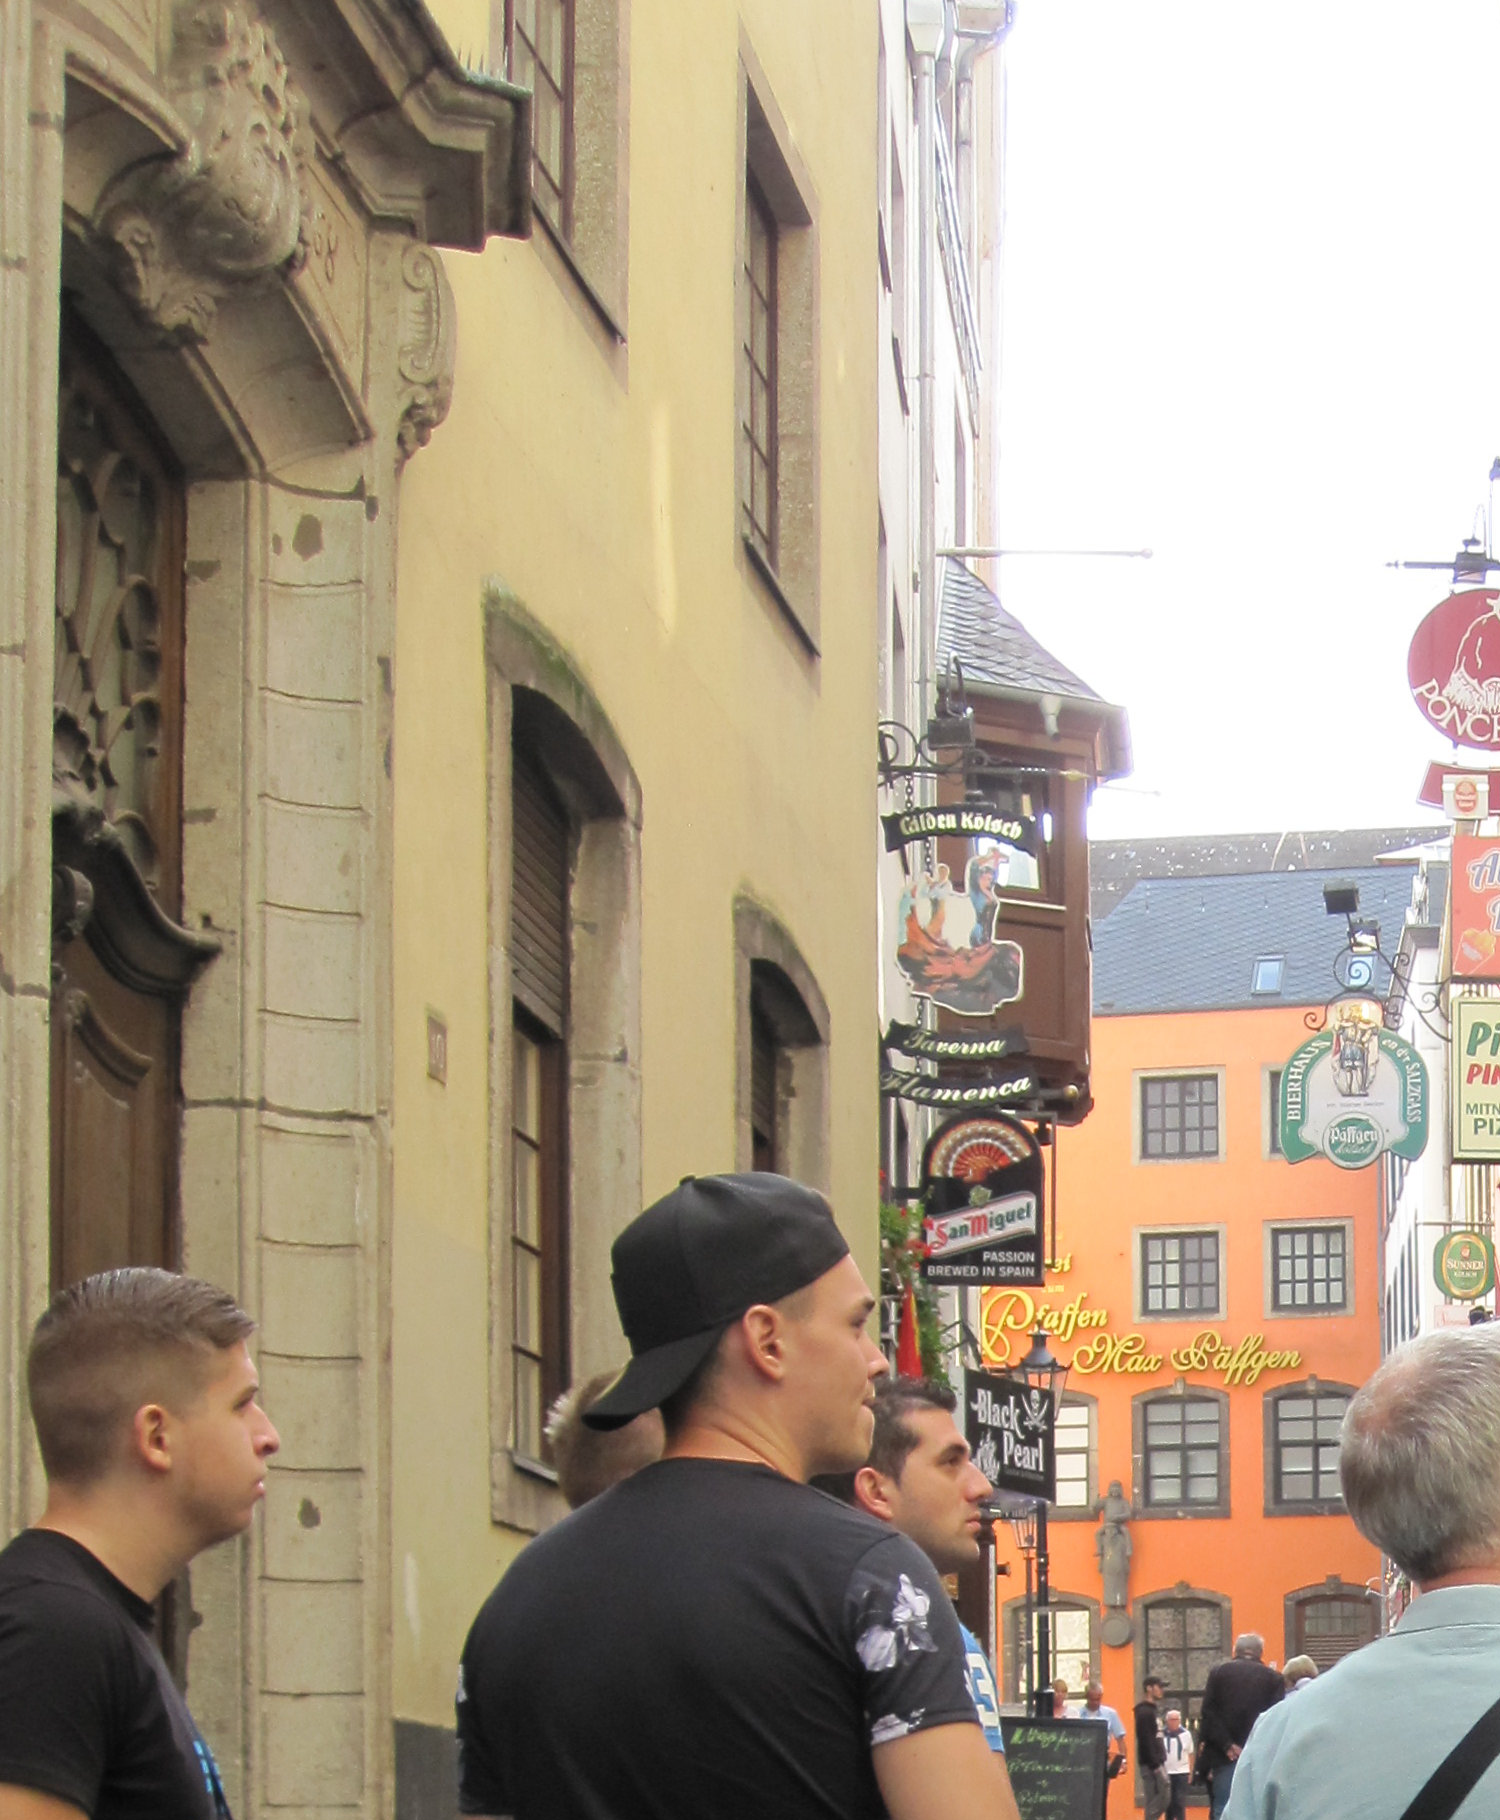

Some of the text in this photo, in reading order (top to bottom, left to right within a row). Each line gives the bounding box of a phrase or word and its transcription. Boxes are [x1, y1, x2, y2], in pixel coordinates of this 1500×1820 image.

[960, 811, 1023, 840] Kölsch
[904, 1029, 1006, 1056] Taverna
[880, 1071, 1031, 1102] Flamenca
[1287, 1039, 1331, 1121] BIERHAUS
[1404, 1061, 1422, 1123] SALZGASS
[927, 1265, 1035, 1277] BREWED IN SPAIN
[982, 1251, 1035, 1263] PASSION
[980, 1287, 1108, 1363] Pfaffen
[1072, 1330, 1302, 1385] Max Päffgen
[970, 1388, 1025, 1439] Black
[1003, 1430, 1044, 1472] Pearl
